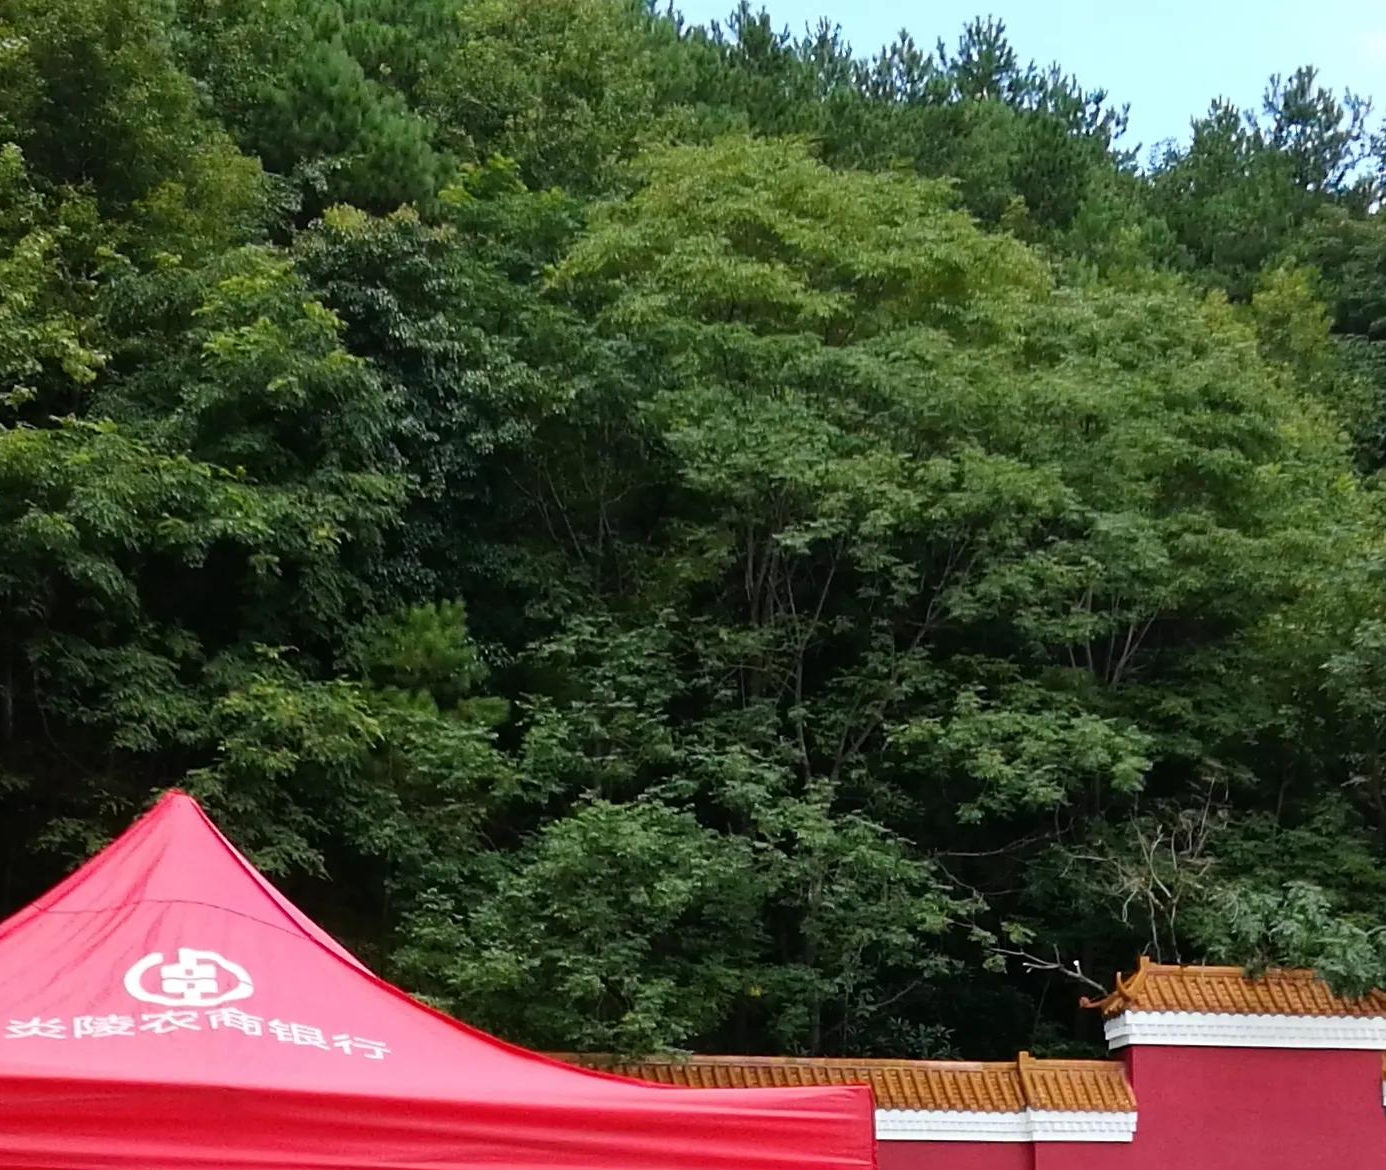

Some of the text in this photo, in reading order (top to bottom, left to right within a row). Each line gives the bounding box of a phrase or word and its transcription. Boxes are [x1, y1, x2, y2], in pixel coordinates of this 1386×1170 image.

[4, 1006, 391, 1060] 炎陵农商银行
